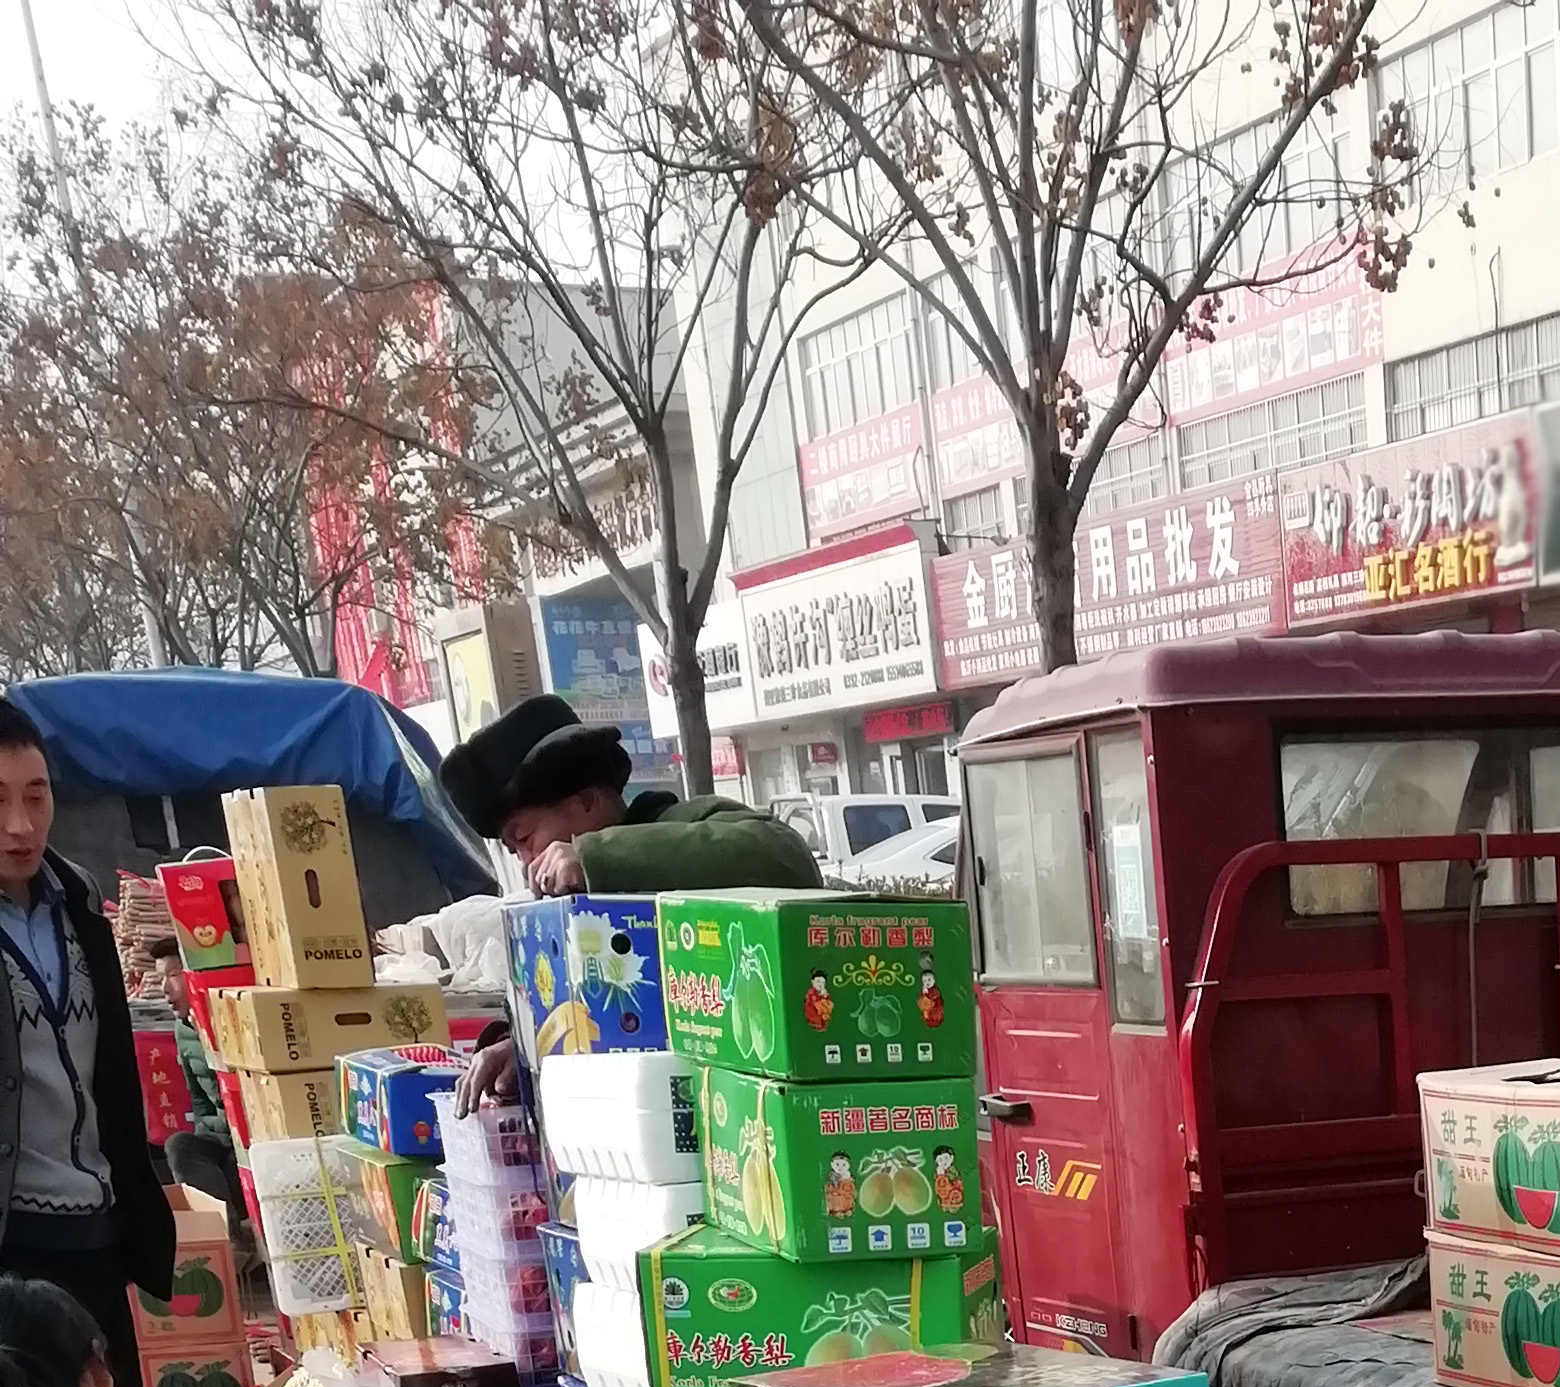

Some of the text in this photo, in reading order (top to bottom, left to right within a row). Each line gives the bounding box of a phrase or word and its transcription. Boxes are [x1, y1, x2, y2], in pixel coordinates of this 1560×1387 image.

[962, 496, 1241, 629] 金厨用品批发
[1363, 527, 1494, 602] 亚汇名酒行
[304, 948, 363, 961] POMELO
[807, 925, 935, 948] 库尔勒香梨
[279, 1002, 300, 1061] POMELO
[820, 1105, 960, 1135] 新疆著名商标
[1441, 1109, 1482, 1148] 甜王
[1015, 1149, 1056, 1194] 正康
[911, 1227, 925, 1236] 10
[1449, 1262, 1492, 1302] 甜王
